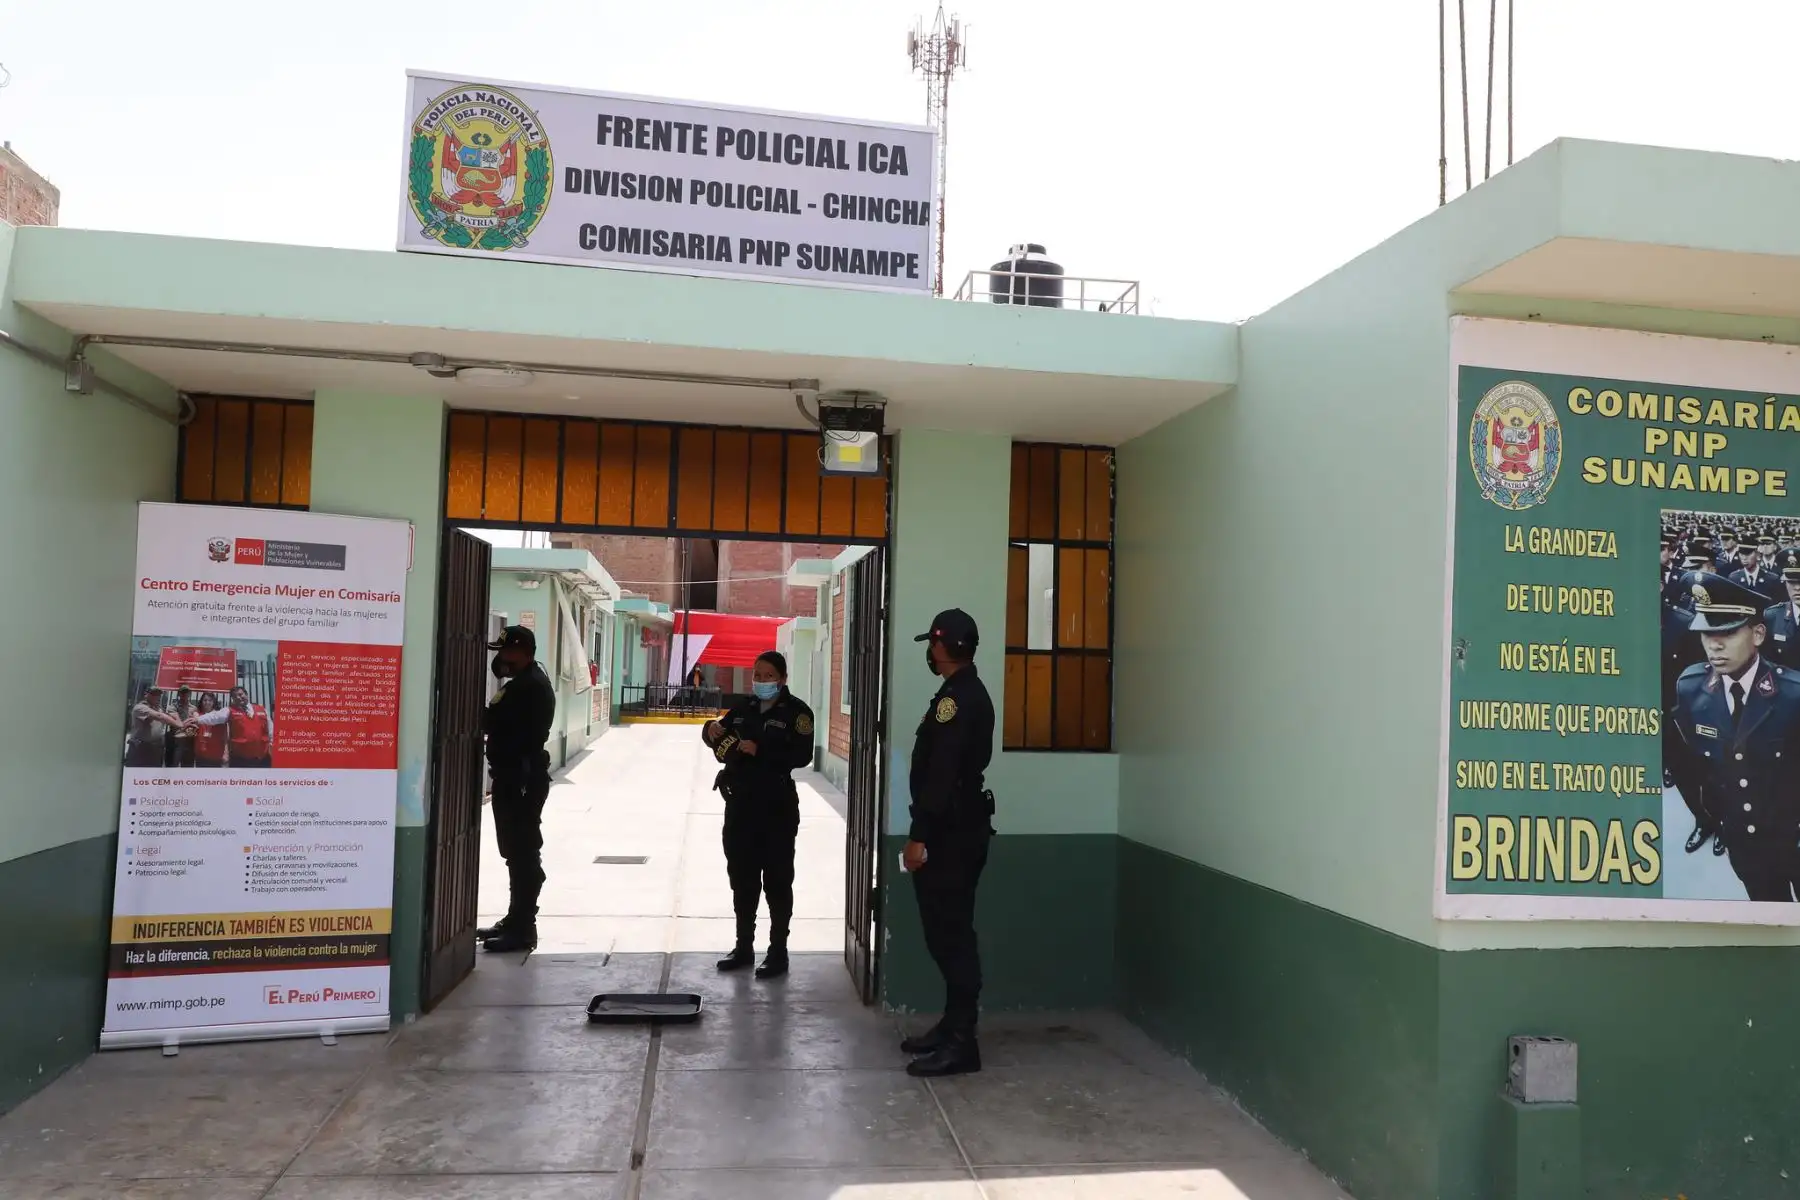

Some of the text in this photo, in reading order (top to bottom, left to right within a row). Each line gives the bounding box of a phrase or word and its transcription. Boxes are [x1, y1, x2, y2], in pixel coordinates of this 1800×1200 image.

[423, 92, 540, 140] POLICIA NACIONAL
[454, 108, 510, 127] DEL PERU
[597, 113, 909, 176] FRENTE POLICIAL ICA
[564, 166, 683, 204] DIVISION
[690, 179, 802, 215] POLICIAL
[823, 192, 931, 226] CHINCHA
[459, 215, 494, 227] PATRIA
[579, 222, 919, 279] COMISARIA PNP SUNAMPE
[1567, 386, 1800, 432] COMISARÍA
[1644, 426, 1728, 459] PNP
[1581, 455, 1788, 497] SUNAMPE
[237, 547, 261, 556] PERÚ
[268, 543, 300, 551] Ministerio
[1504, 524, 1618, 559] LA GRANDEZA
[268, 557, 305, 565] Poblaciones
[141, 577, 401, 603] Centro Emergencia Mujer en Comisaría
[1506, 583, 1615, 617] DE TU PODER
[147, 599, 189, 609] Atención
[191, 601, 226, 611] gratuita
[228, 602, 256, 612] frente
[265, 604, 273, 613] la
[275, 605, 313, 615] violencia
[340, 608, 352, 617] las
[353, 609, 388, 620] mujeres
[210, 613, 261, 625] integrantes
[262, 615, 277, 625] del
[278, 618, 305, 627] grupo
[307, 617, 339, 628] familiar
[1499, 638, 1620, 675] NO ESTÁ EN EL
[1459, 700, 1660, 737] UNIFORME QUE PORTAS
[133, 778, 149, 786] Los
[151, 778, 171, 786] CEM
[229, 778, 263, 786] brindan
[264, 778, 277, 786] los
[279, 778, 316, 786] servicios
[317, 778, 329, 786] de
[1456, 760, 1662, 799] SINO EN EL TRATO QUE...
[255, 796, 284, 806] Social
[139, 810, 166, 818] Soporte
[136, 846, 161, 857] Legal
[252, 842, 364, 853] Prevención y Promoción
[1452, 814, 1662, 886] BRINDAS
[133, 915, 373, 939] INDIFERENCIA TAMBIÉN ES VIOLENCIA
[125, 942, 378, 964] Haz la diferencia, rechaza la violencia contra la mujer
[116, 996, 226, 1011] www.mimp.gob.pe
